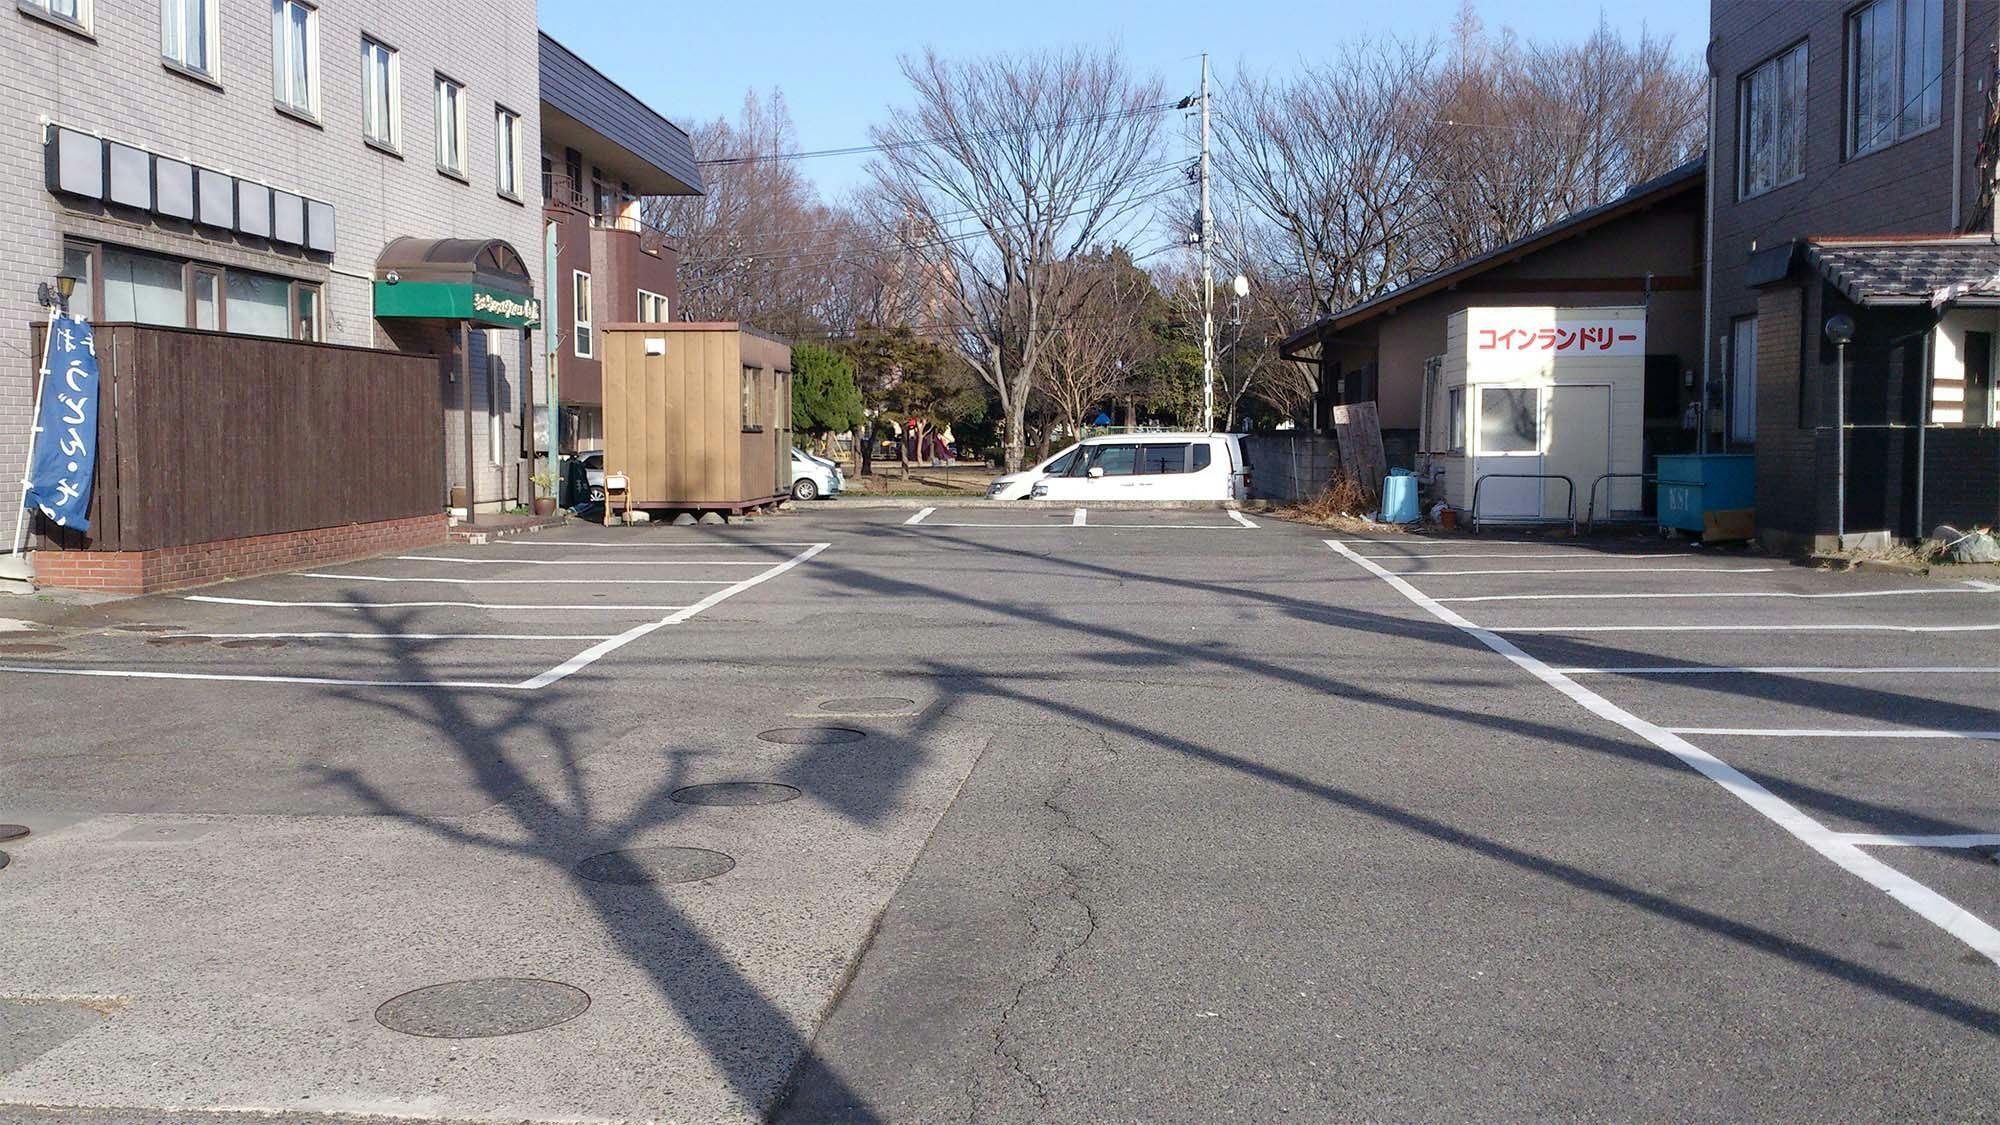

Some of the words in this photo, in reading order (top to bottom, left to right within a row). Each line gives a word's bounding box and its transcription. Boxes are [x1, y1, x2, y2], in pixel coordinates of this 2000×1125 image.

[1479, 327, 1637, 351] コインランドリー
